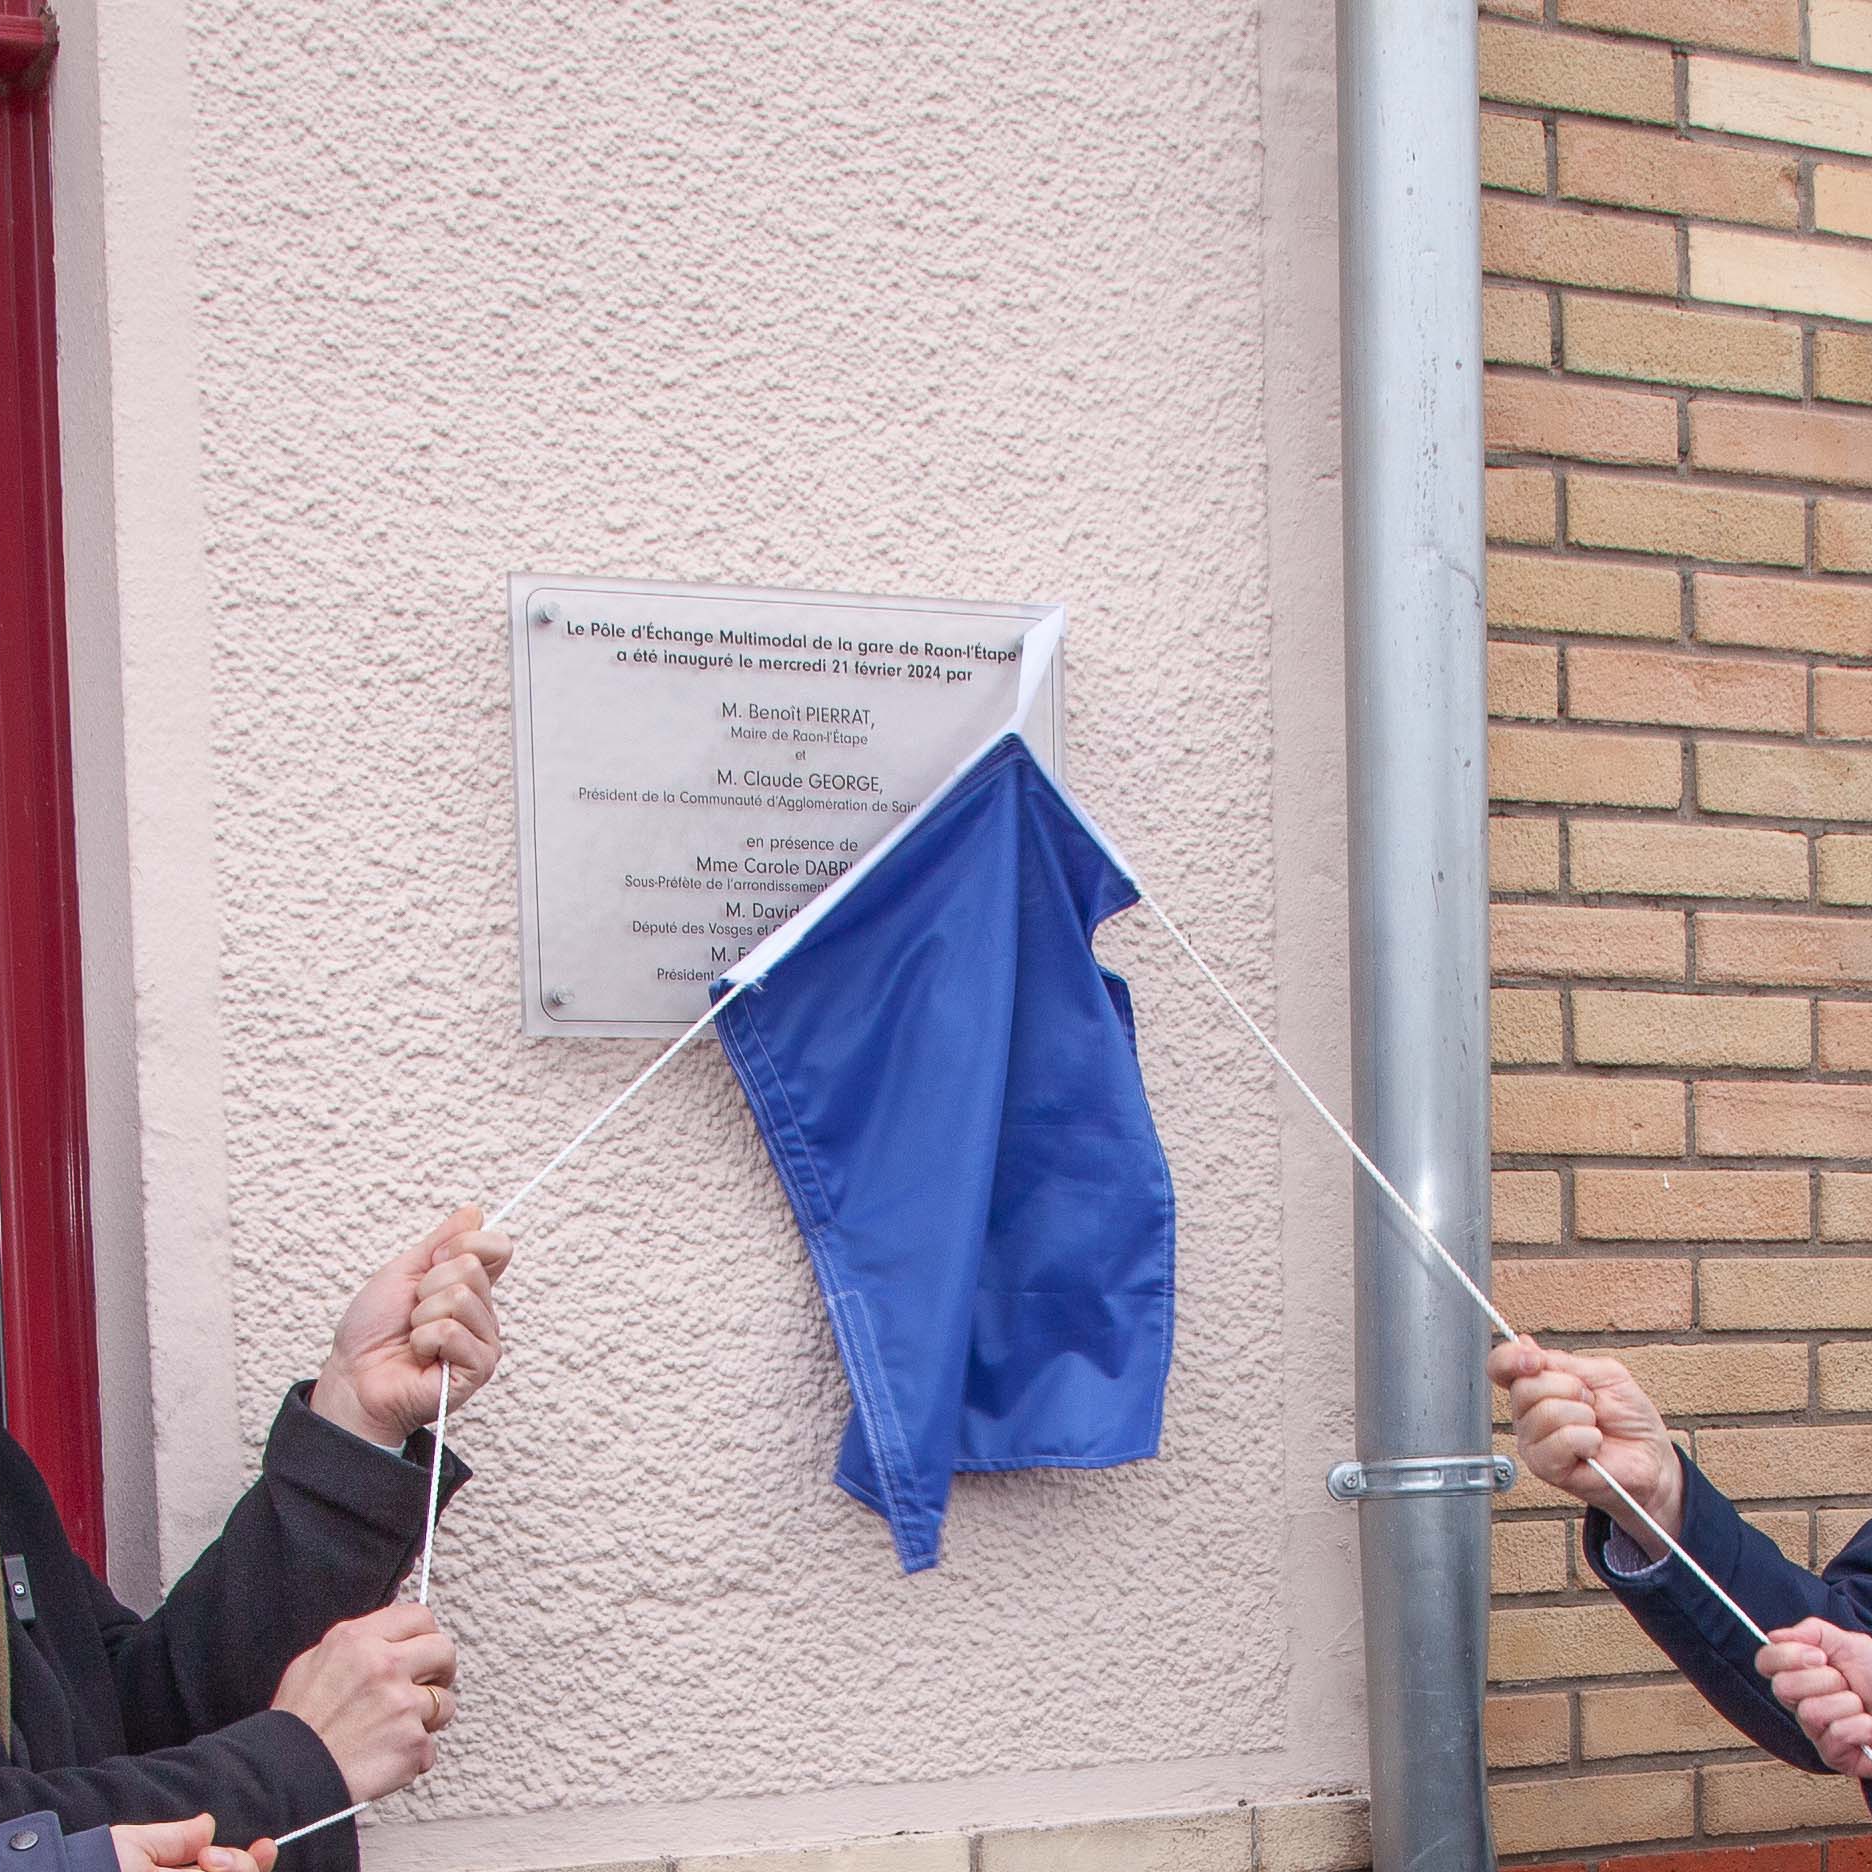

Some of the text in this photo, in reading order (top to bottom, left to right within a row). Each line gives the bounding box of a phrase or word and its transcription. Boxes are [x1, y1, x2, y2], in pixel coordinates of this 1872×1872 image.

[566, 621, 1017, 664] Le Pôle d'Échange Multimodal de la gare de Raon-l'Étape
[616, 648, 973, 684] a été inauguré le mercredi 21 février 2024 par
[722, 702, 875, 729] M. Benoît PIERRAT,
[731, 726, 868, 747] Maire de Raon-l'Étape
[795, 750, 806, 761] et
[717, 769, 883, 795] M. Claude GEORGE,
[579, 787, 638, 802] Président
[642, 789, 659, 802] de
[663, 790, 675, 803] la
[680, 791, 762, 807] Communauté
[767, 794, 868, 812] d'Agglomération
[872, 800, 888, 813] de
[746, 836, 858, 852] en présence de
[696, 856, 854, 877] Mme Carole DABR
[625, 875, 702, 890] Sous-Préfète
[706, 876, 723, 890] de
[726, 902, 800, 919] M. David
[632, 920, 677, 936] Député
[681, 921, 704, 935] des
[708, 923, 753, 939] Vosges
[757, 923, 769, 936] et
[711, 947, 730, 962] M.
[657, 968, 714, 982] Président
